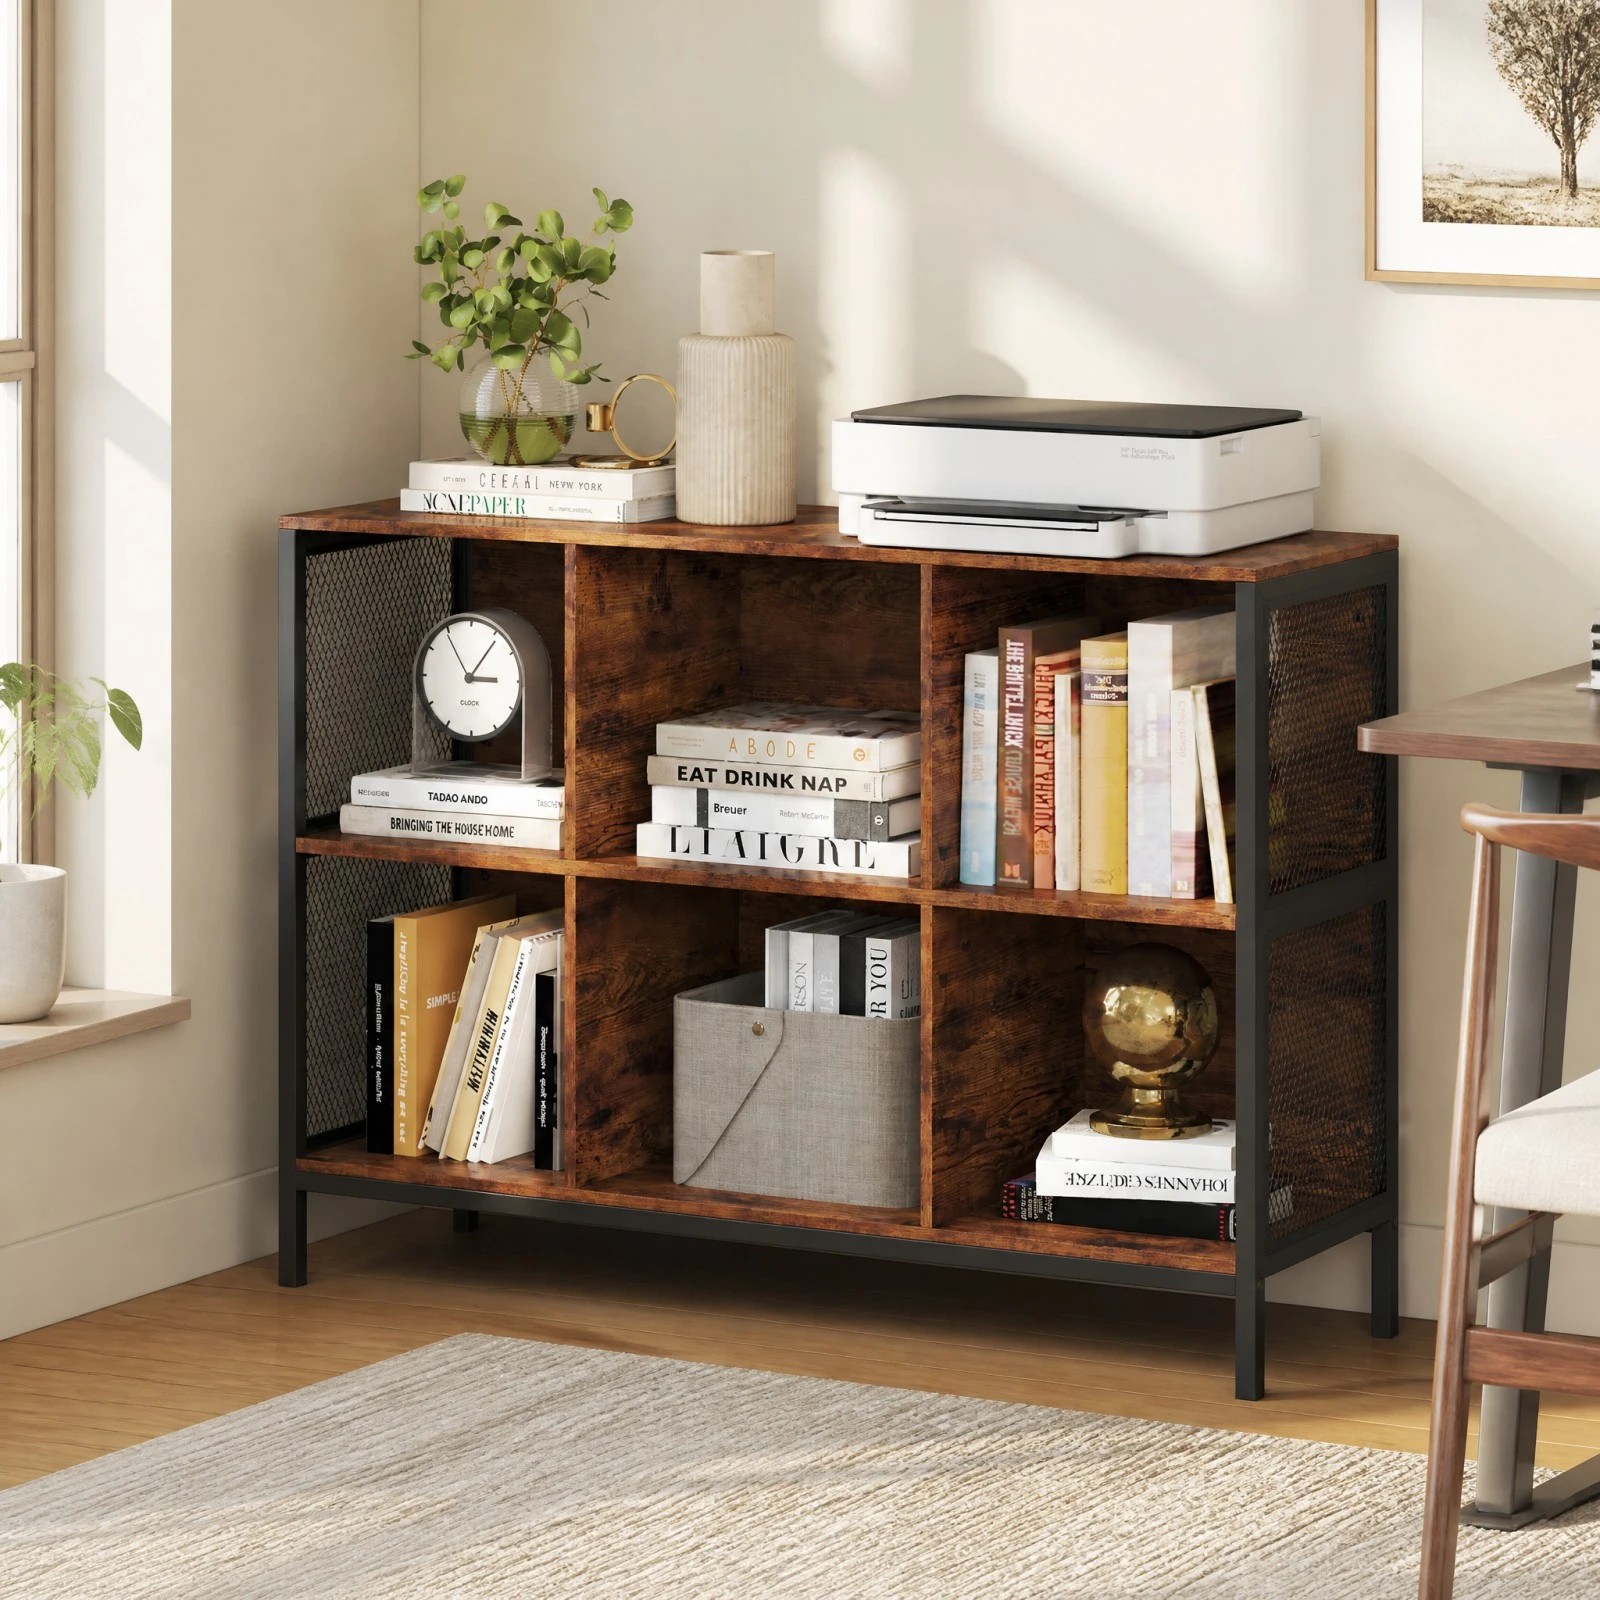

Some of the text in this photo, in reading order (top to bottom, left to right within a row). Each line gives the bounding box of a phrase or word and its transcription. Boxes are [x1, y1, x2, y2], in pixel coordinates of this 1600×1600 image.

[578, 482, 603, 492] YORK
[460, 699, 480, 707] CLOCK
[729, 737, 816, 760] ABODE
[677, 765, 718, 783] EAT
[725, 769, 795, 790] DRINK
[801, 775, 847, 793] NAP
[428, 791, 488, 805] TADAO ANDO
[713, 802, 748, 816] Breuer
[390, 817, 515, 839] BRINGING THE HOUSE HOME
[870, 947, 888, 1019] R YOU
[426, 991, 457, 1009] SIMPLE
[1144, 1173, 1228, 1192] JOHANNES
